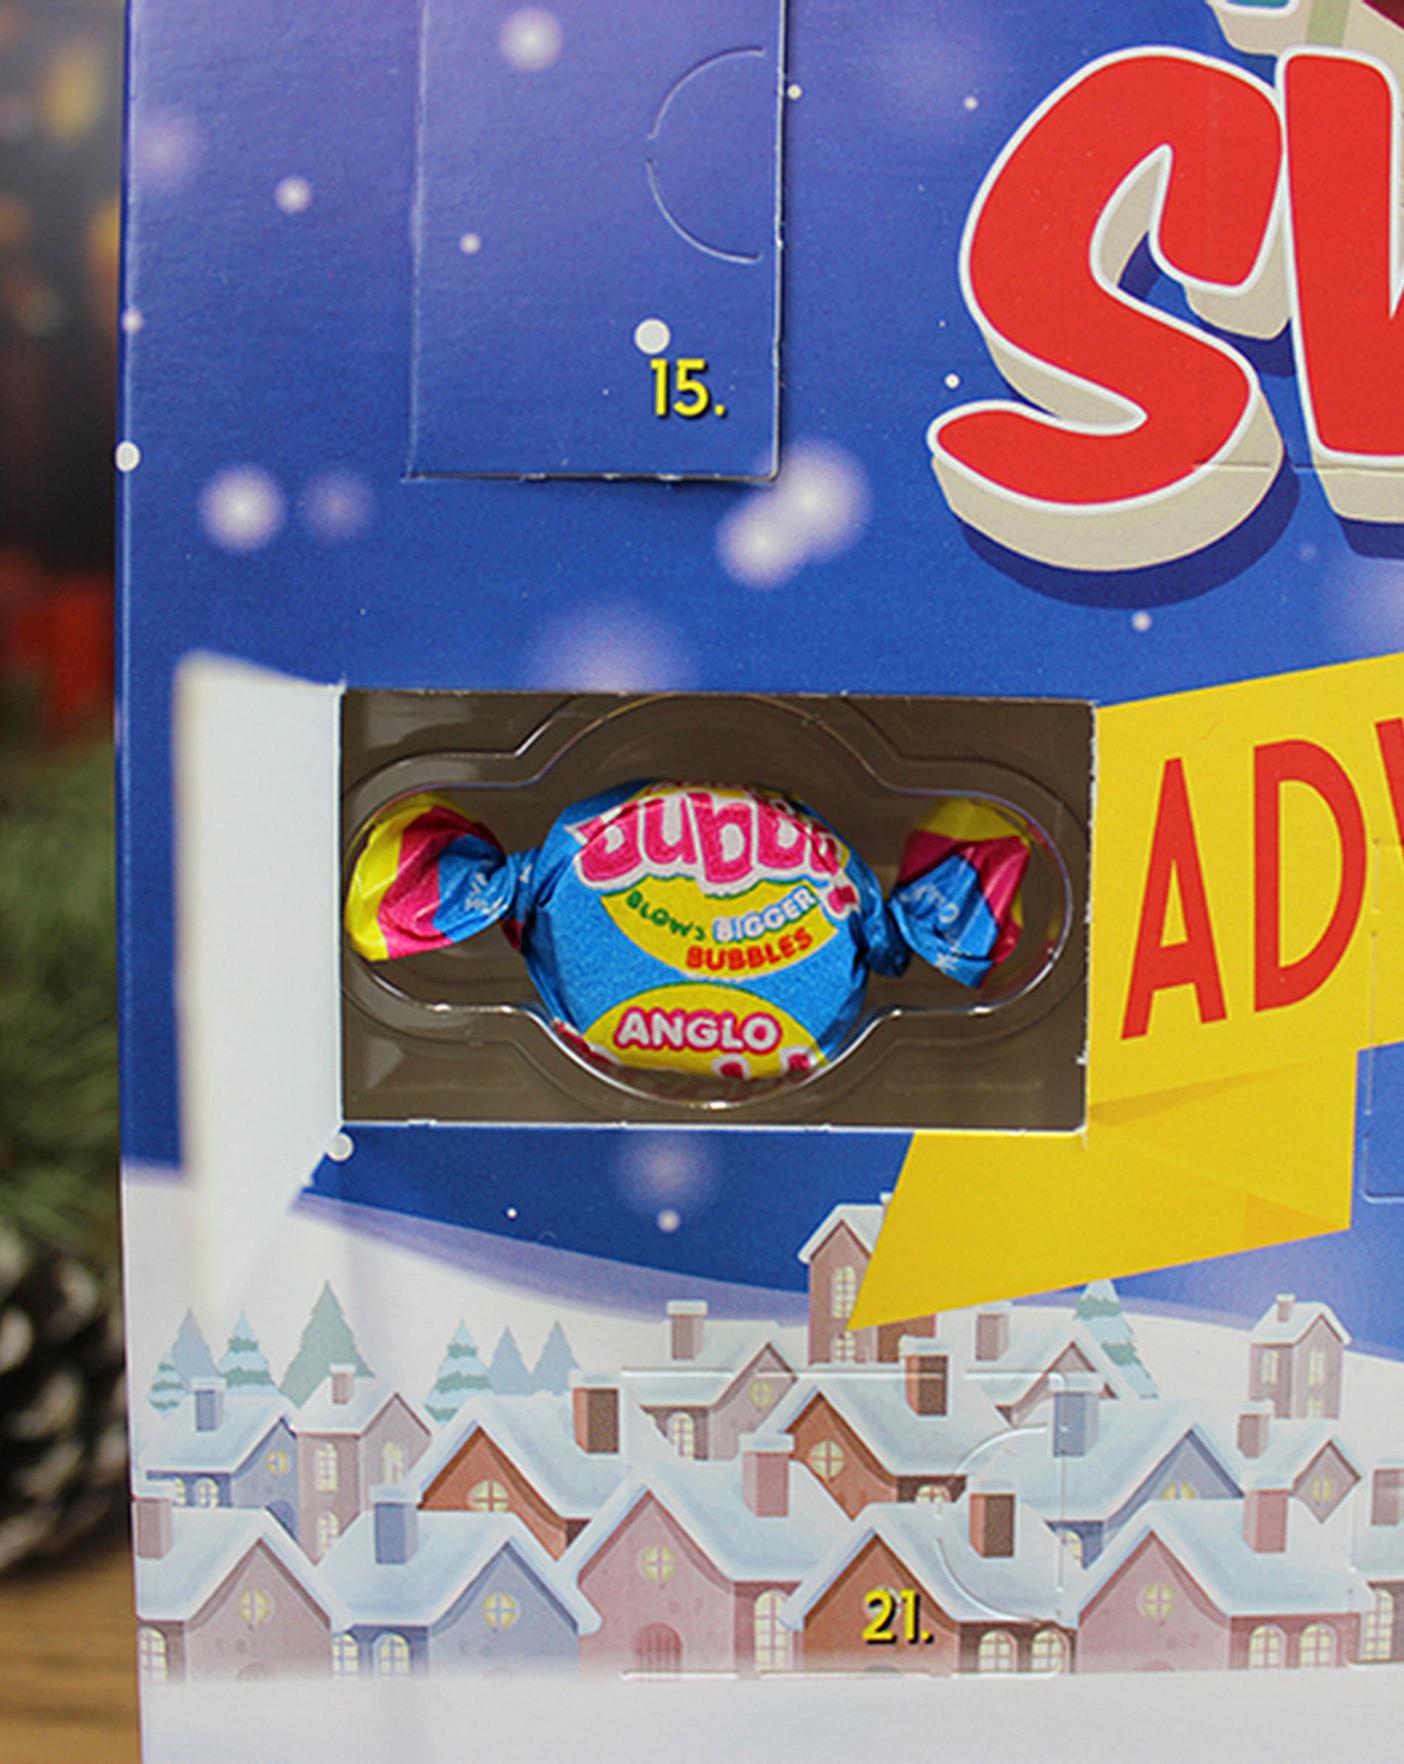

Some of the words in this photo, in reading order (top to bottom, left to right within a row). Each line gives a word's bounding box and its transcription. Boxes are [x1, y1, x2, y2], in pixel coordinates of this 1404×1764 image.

[650, 358, 727, 417] 15.
[712, 884, 821, 944] BIGGER
[686, 926, 813, 971] BUBBLES
[614, 1006, 782, 1053] ANGLO
[862, 1588, 935, 1645] 21.
